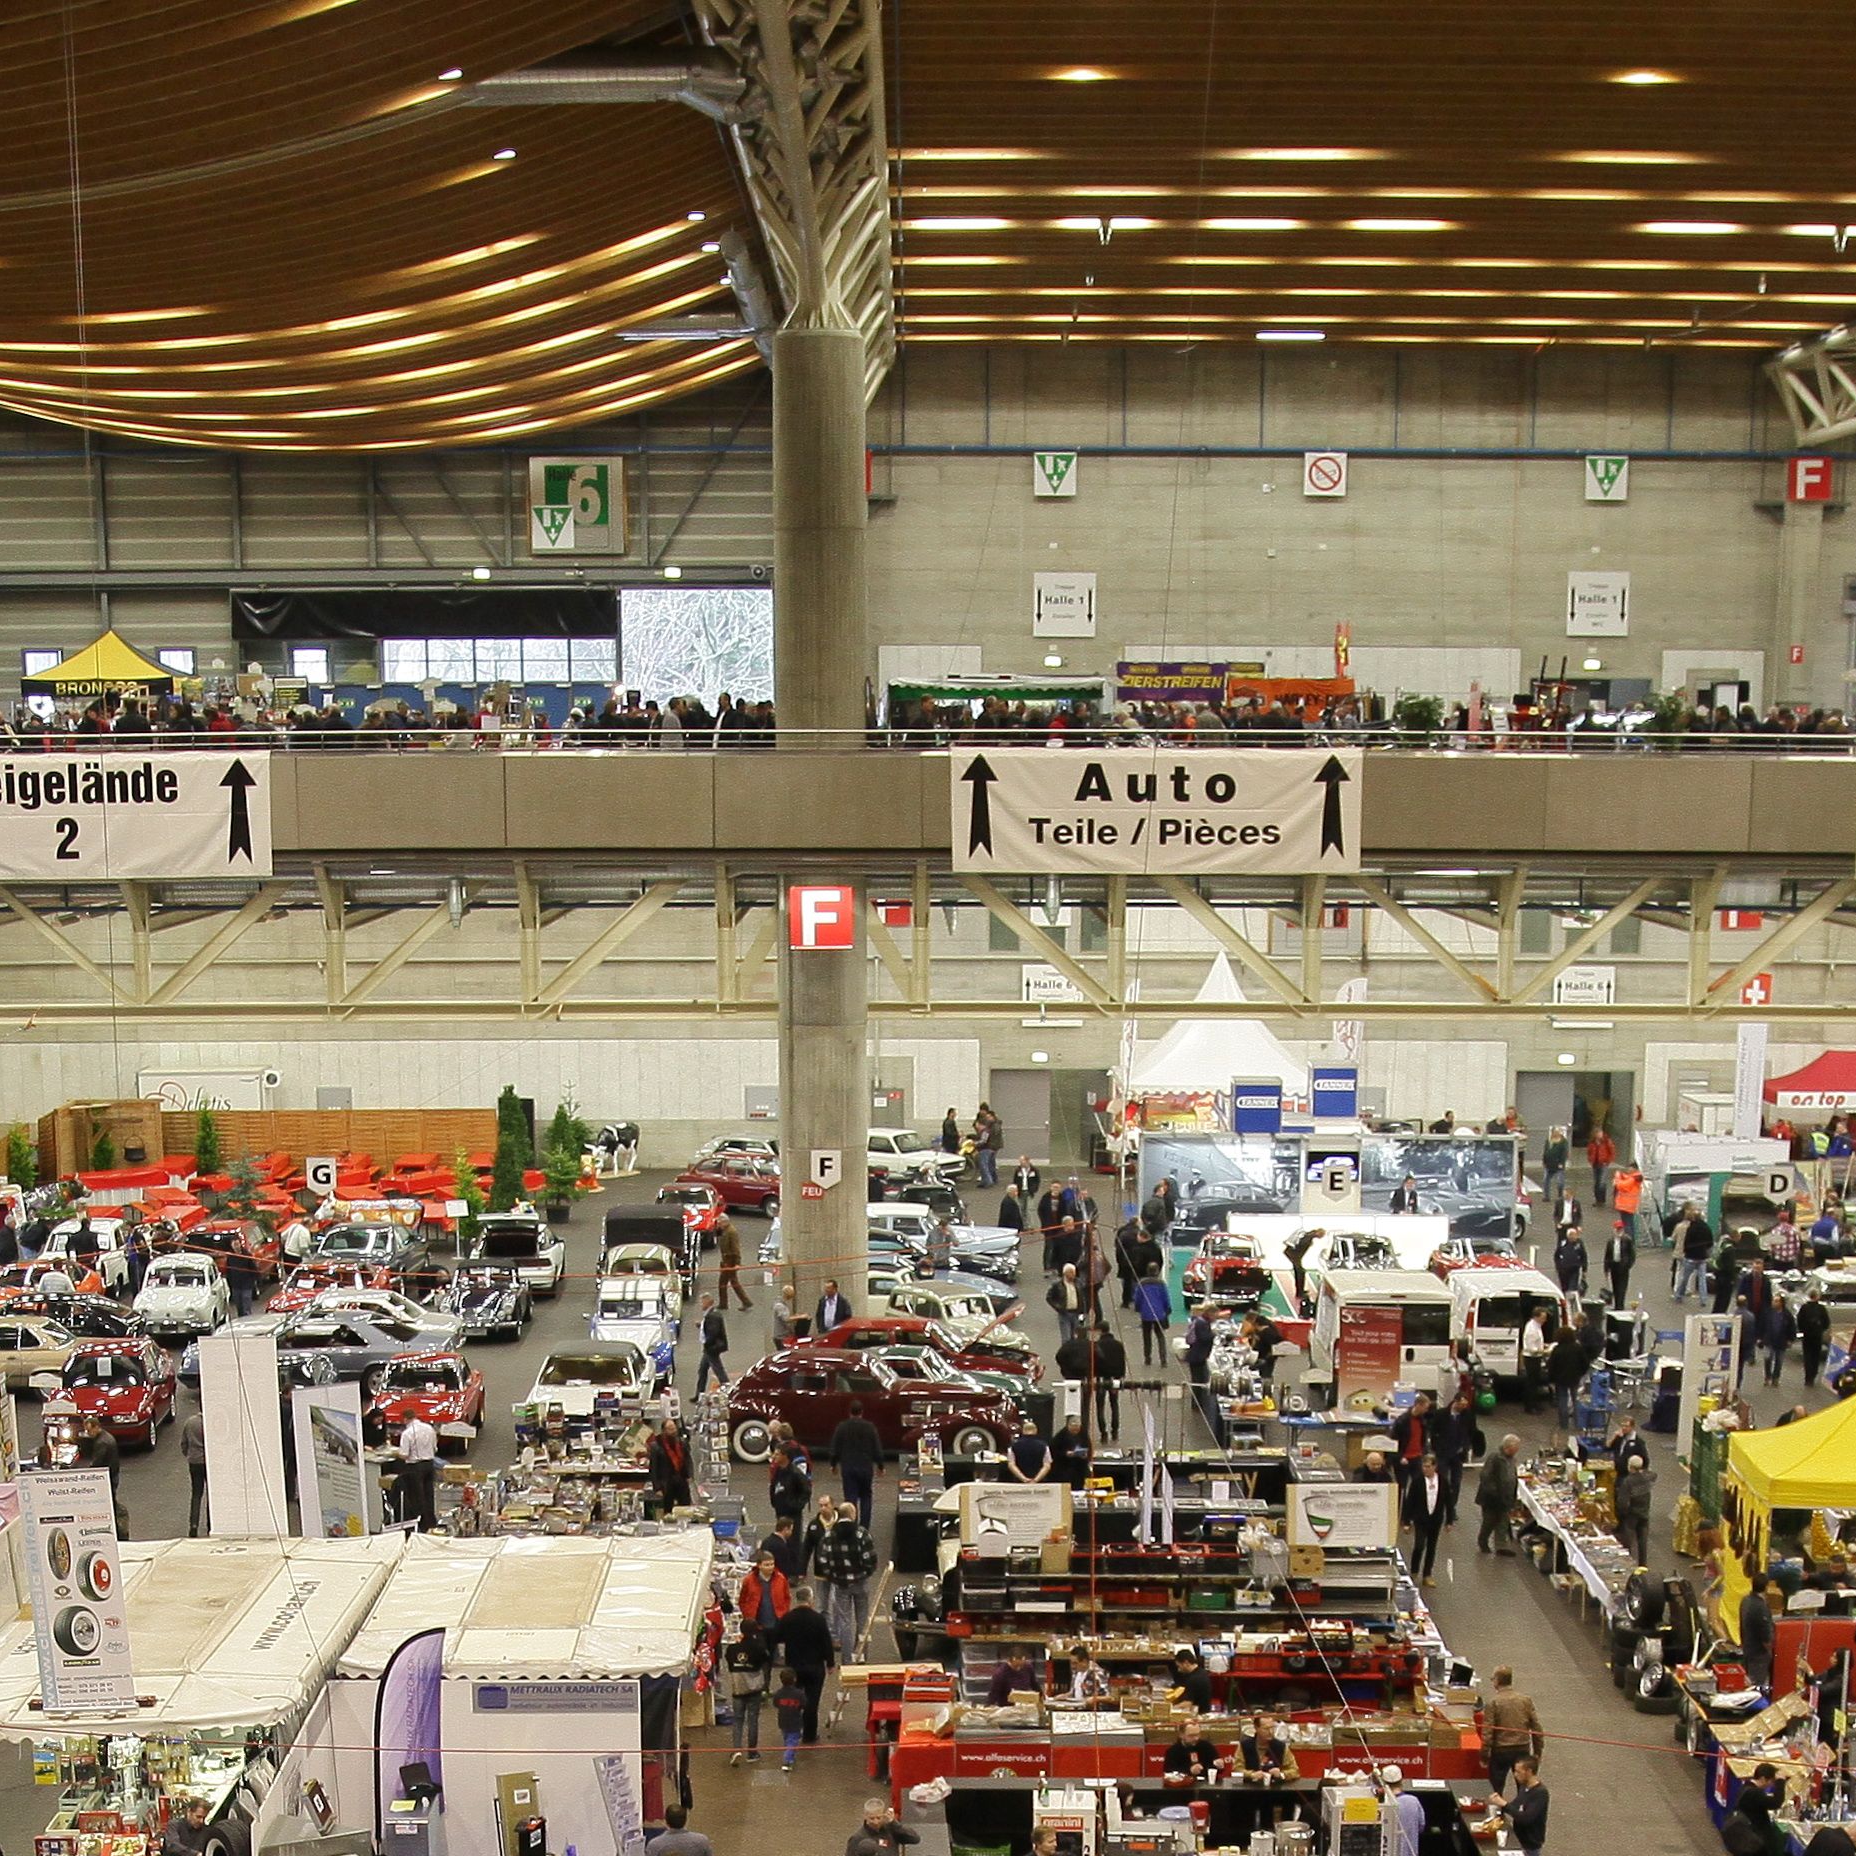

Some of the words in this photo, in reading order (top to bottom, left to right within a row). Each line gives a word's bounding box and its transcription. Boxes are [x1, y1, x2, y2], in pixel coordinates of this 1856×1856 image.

[1796, 459, 1823, 499] F
[567, 466, 601, 525] 6
[1074, 766, 1238, 803] Auto
[54, 817, 80, 860] 2
[1028, 817, 1117, 845] Teile
[1158, 817, 1282, 846] Pièces
[800, 890, 841, 945] F
[1239, 1098, 1278, 1108] TANNER
[1816, 1092, 1845, 1108] top
[312, 1165, 331, 1184] G
[819, 1157, 833, 1177] F
[1330, 1172, 1344, 1190] E
[1770, 1174, 1788, 1193] D
[802, 1186, 822, 1196] FEU
[19, 1478, 58, 1707] www.classicreifen.ch
[510, 1685, 563, 1693] METTRAUX
[565, 1685, 618, 1693] RADIATECH
[620, 1685, 633, 1693] SA
[961, 1753, 1046, 1764] www.alfaservice.ch
[1042, 1817, 1082, 1830] granini
